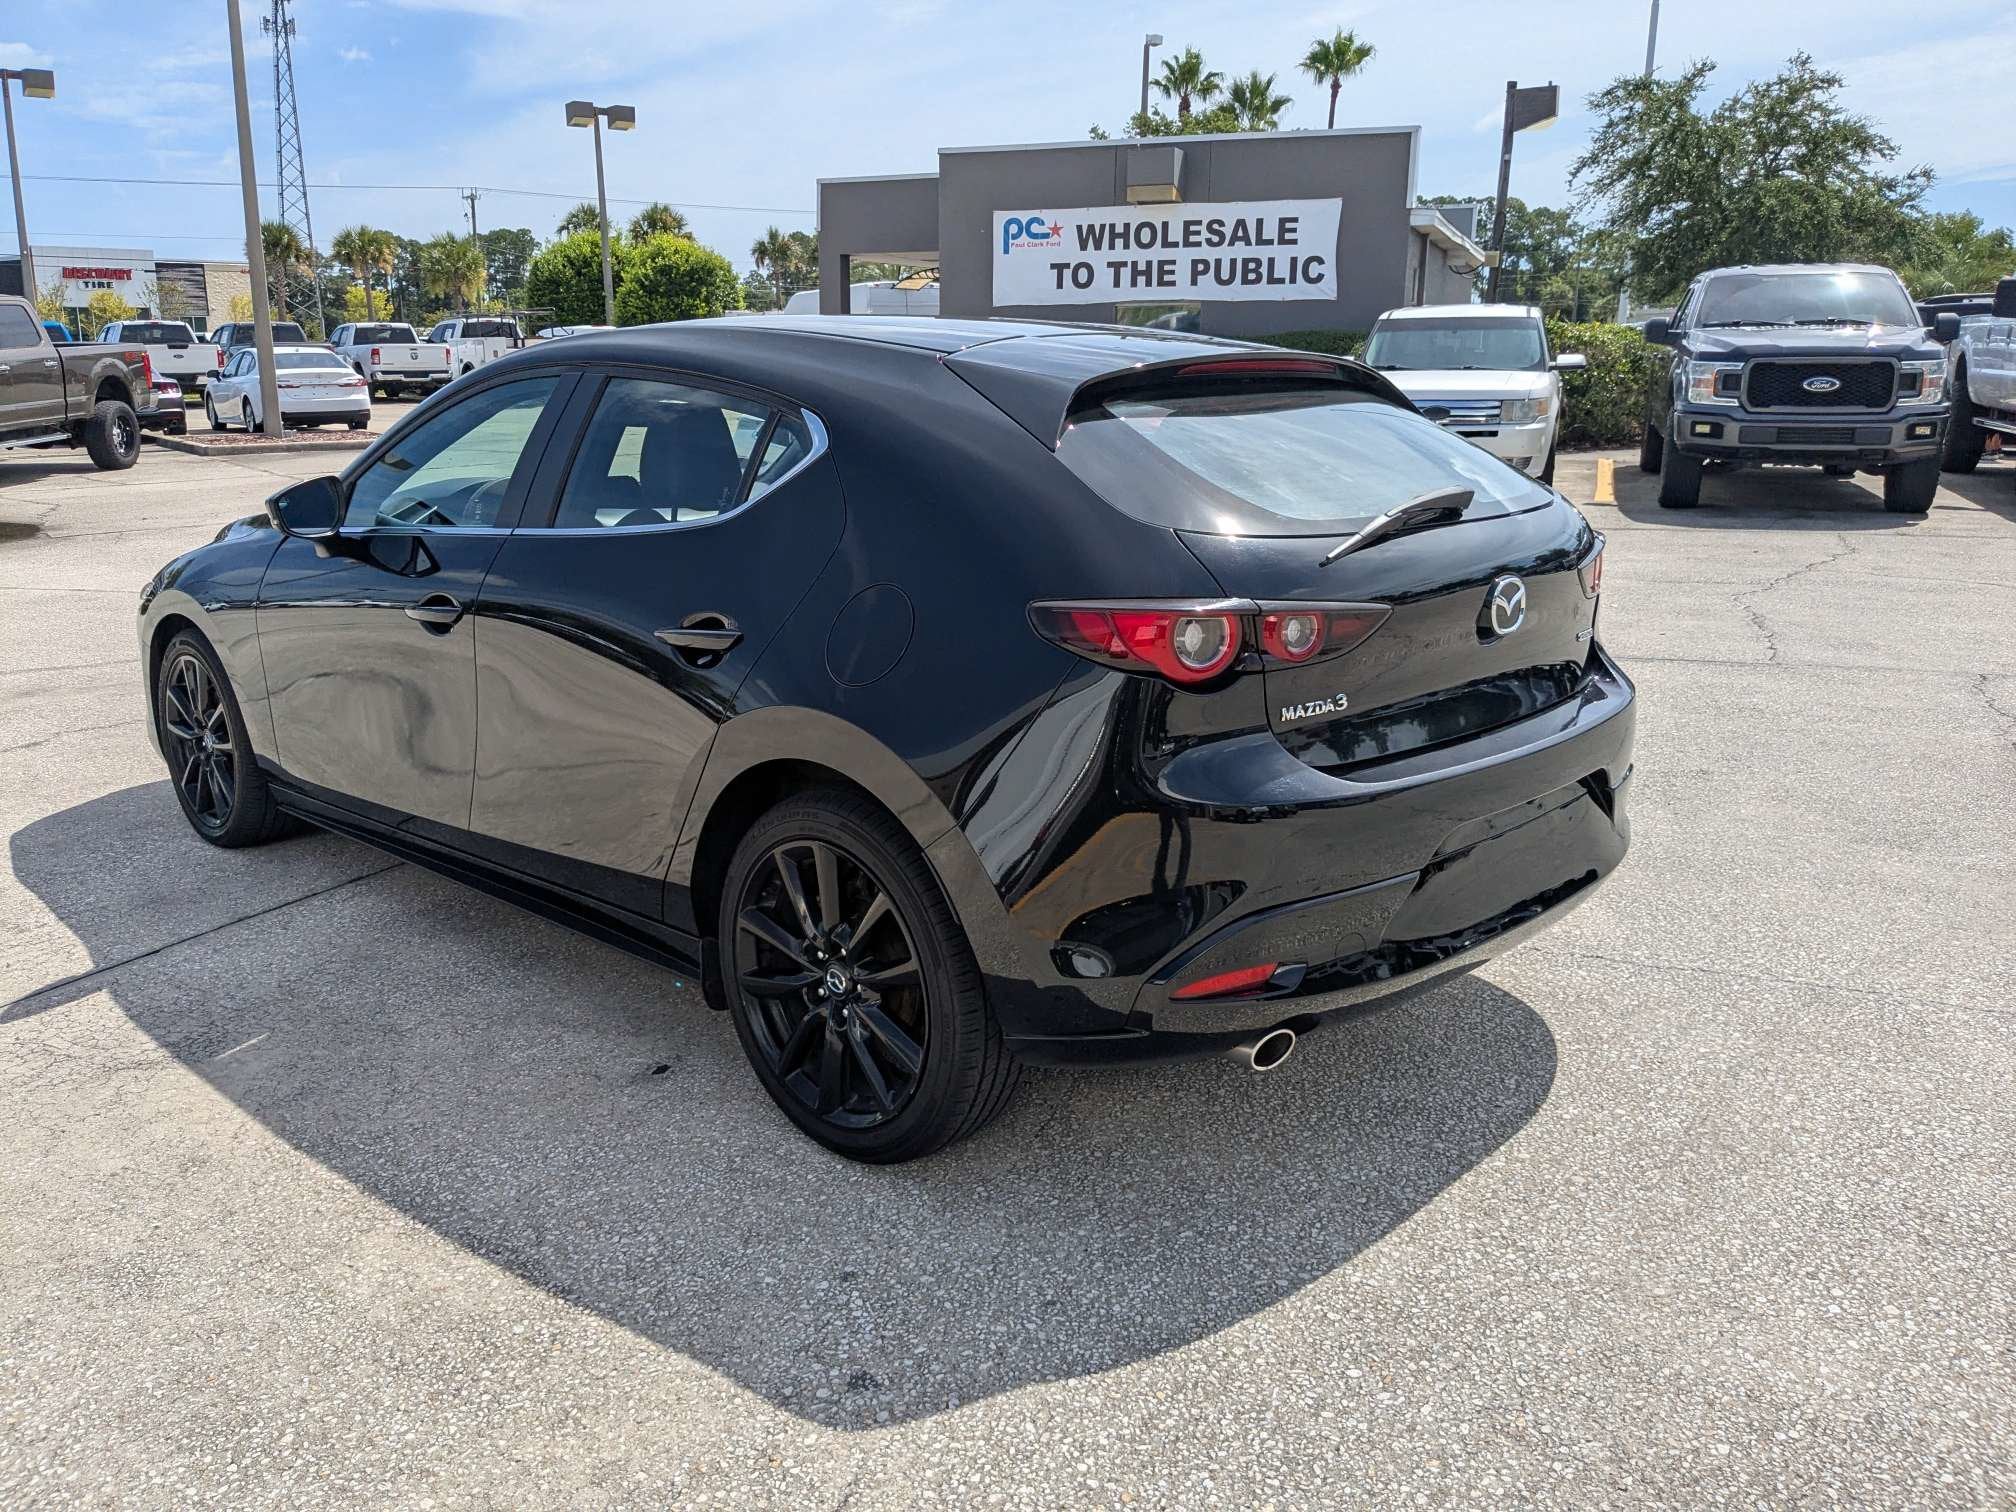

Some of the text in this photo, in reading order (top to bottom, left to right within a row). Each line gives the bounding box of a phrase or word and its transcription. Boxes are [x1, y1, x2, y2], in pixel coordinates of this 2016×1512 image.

[1075, 217, 1299, 252] WHOLESALE
[62, 267, 133, 280] DISCOUNT
[83, 281, 114, 289] TIRE
[1050, 255, 1326, 290] TO THE PUBLIC
[1281, 693, 1348, 721] MAZDA3
